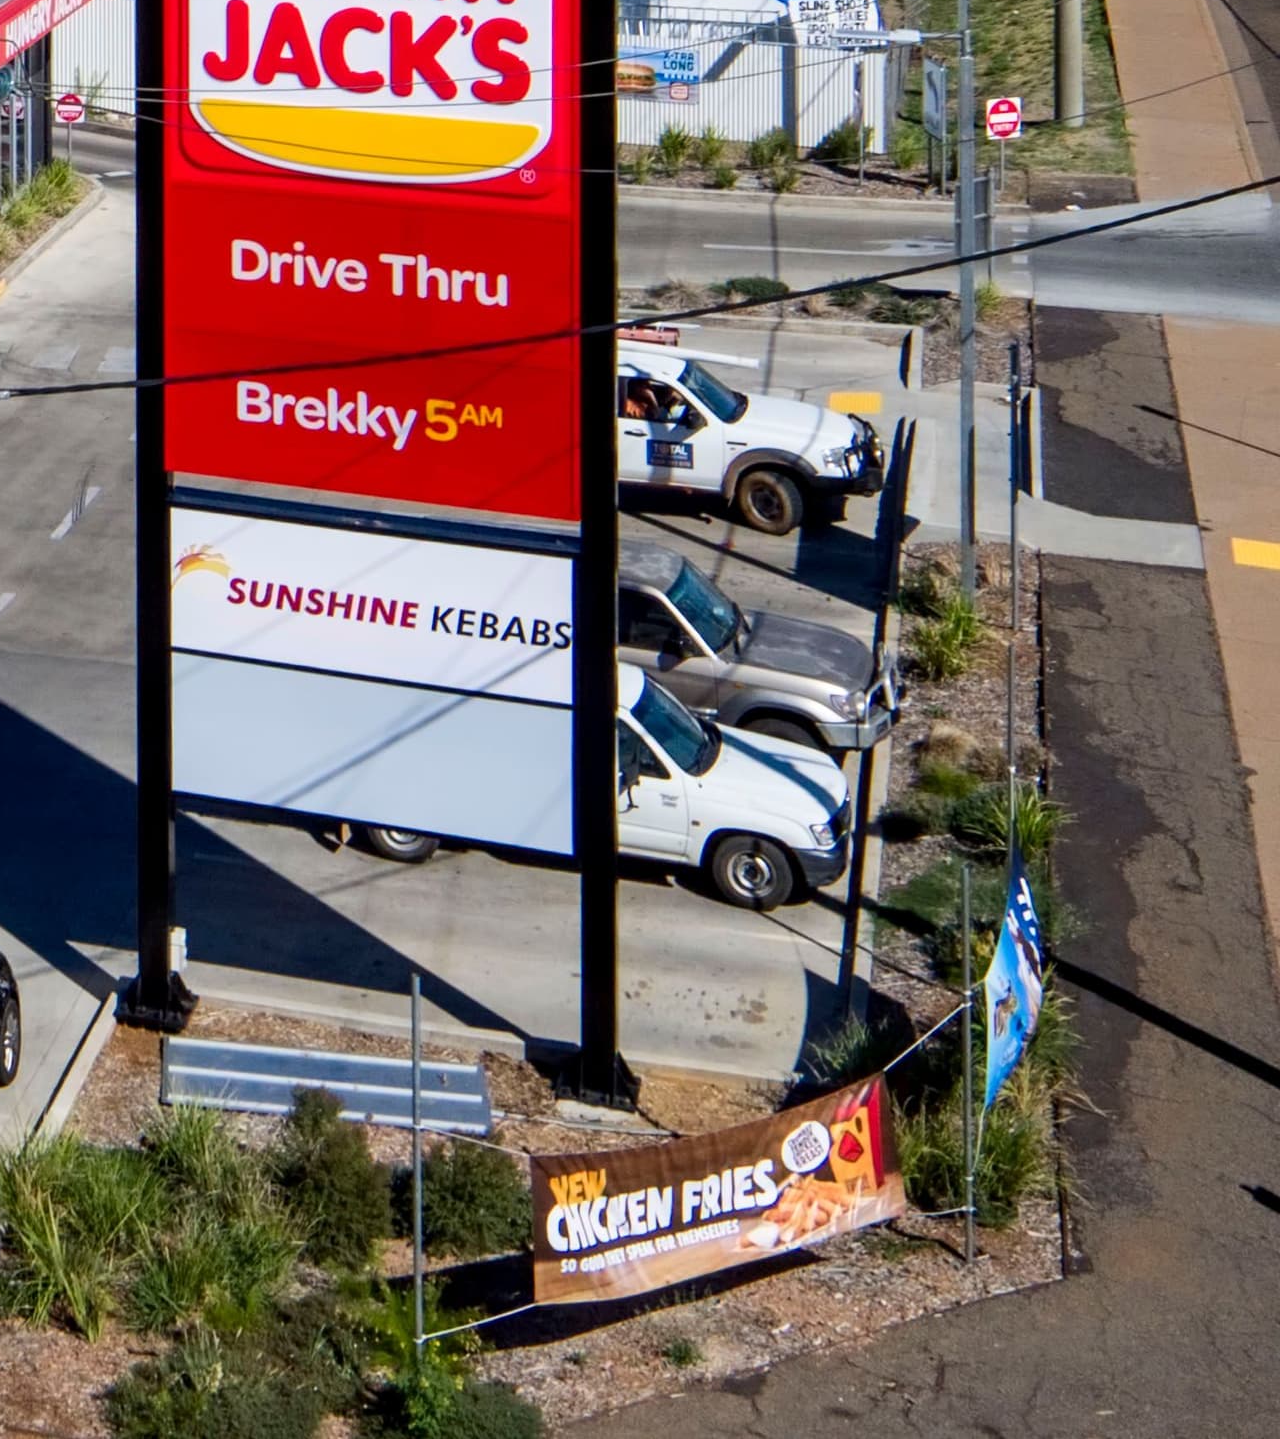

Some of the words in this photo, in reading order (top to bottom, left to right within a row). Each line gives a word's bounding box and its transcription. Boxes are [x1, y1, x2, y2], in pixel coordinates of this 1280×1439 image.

[799, 1, 830, 11] SLING
[203, 0, 531, 104] JACK'S
[663, 61, 694, 72] LONG
[231, 239, 368, 292] Drive
[379, 253, 508, 306] Thru
[236, 380, 417, 450] Brekky
[227, 577, 419, 628] SUNSHINE
[431, 605, 572, 649] KEBABS
[546, 1186, 674, 1253] CHICKEN
[682, 1159, 778, 1224] FRIES
[560, 1259, 577, 1273] SO
[655, 1236, 677, 1253] FOR
[675, 1219, 739, 1248] THEMSELVES
